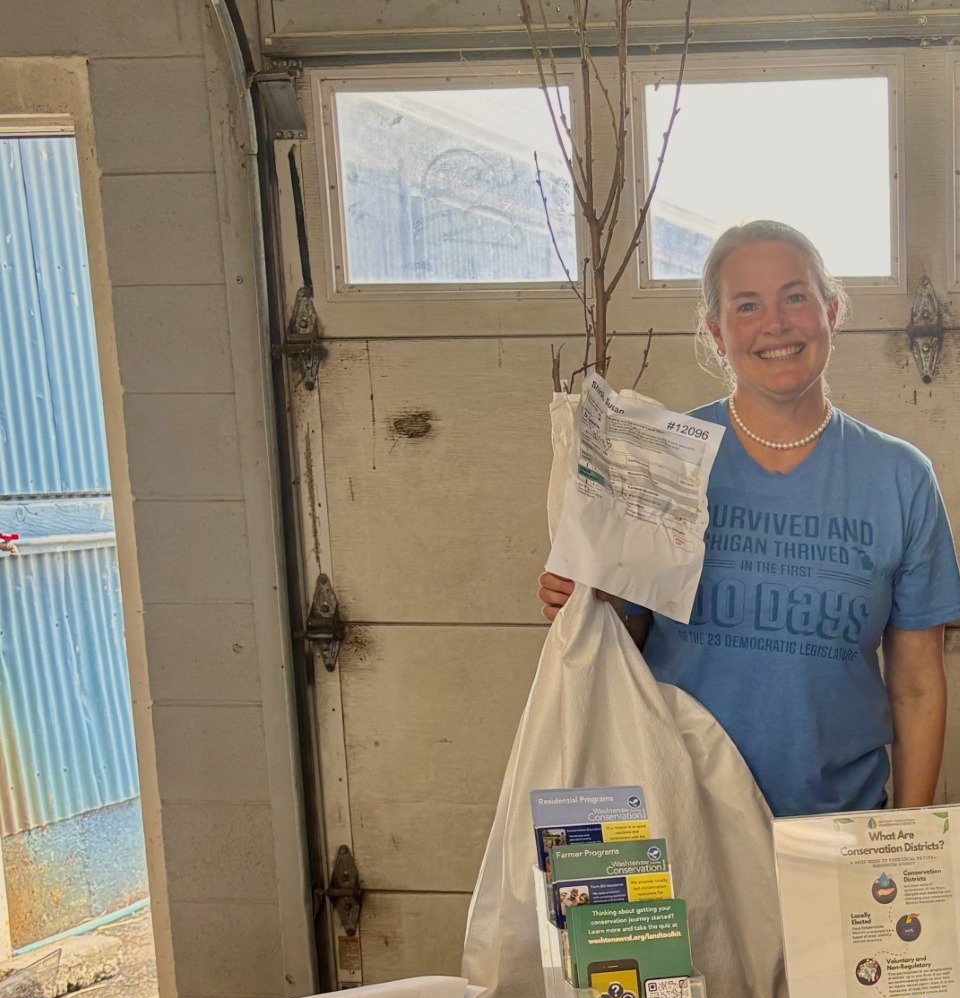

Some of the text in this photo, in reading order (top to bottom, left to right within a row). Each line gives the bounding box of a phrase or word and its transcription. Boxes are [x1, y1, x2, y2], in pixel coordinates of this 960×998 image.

[666, 421, 710, 440] #12096
[711, 504, 820, 539] URVIVED
[827, 517, 874, 547] AND
[704, 534, 849, 565] HIGAN THRIVED
[741, 560, 812, 578] IN THE FIRST
[688, 576, 746, 628] 00
[724, 634, 797, 656] DEMOCRATIC
[580, 796, 613, 804] Programs
[588, 811, 642, 822] Conservation
[868, 830, 914, 841] What Are
[556, 848, 620, 859] Farmer Programs
[841, 840, 944, 856] Conservation Districts?
[607, 864, 661, 874] Conservation
[588, 931, 681, 944] washtenawcd.org/landtoolkit
